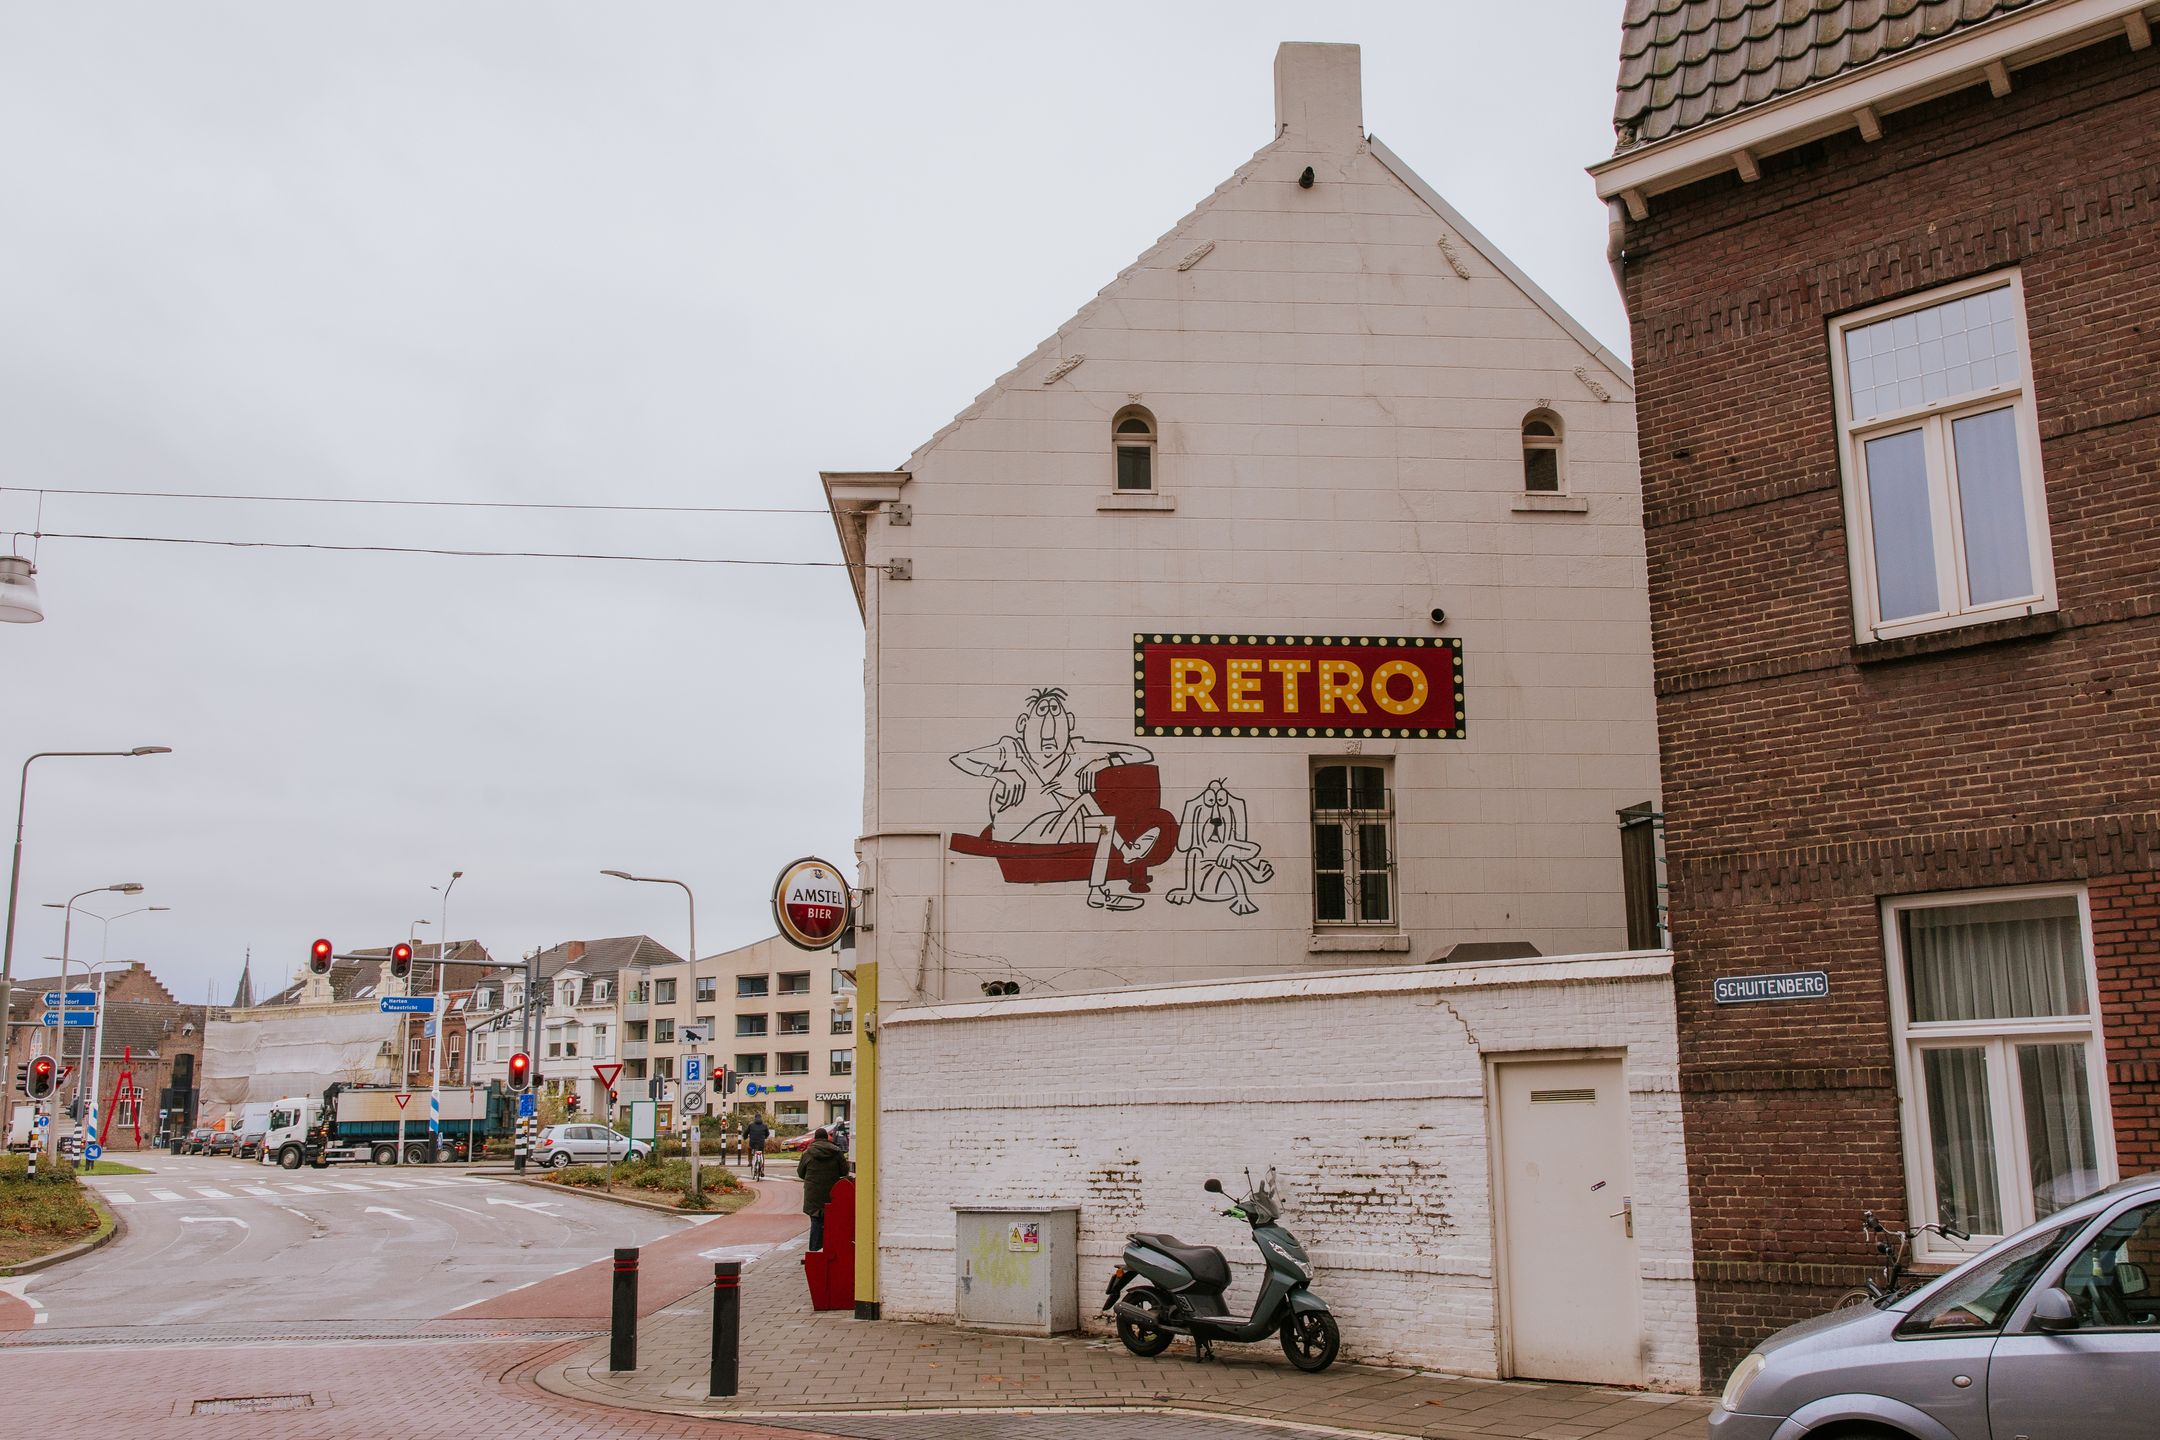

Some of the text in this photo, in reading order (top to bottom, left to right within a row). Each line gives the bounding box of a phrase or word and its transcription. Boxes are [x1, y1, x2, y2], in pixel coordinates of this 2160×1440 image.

[1170, 657, 1429, 715] RETRO
[793, 888, 842, 905] AMSTEL
[807, 907, 831, 919] BIER
[1718, 977, 1824, 997] SCHUITENBERG
[689, 1061, 698, 1073] P
[687, 1097, 699, 1105] 30
